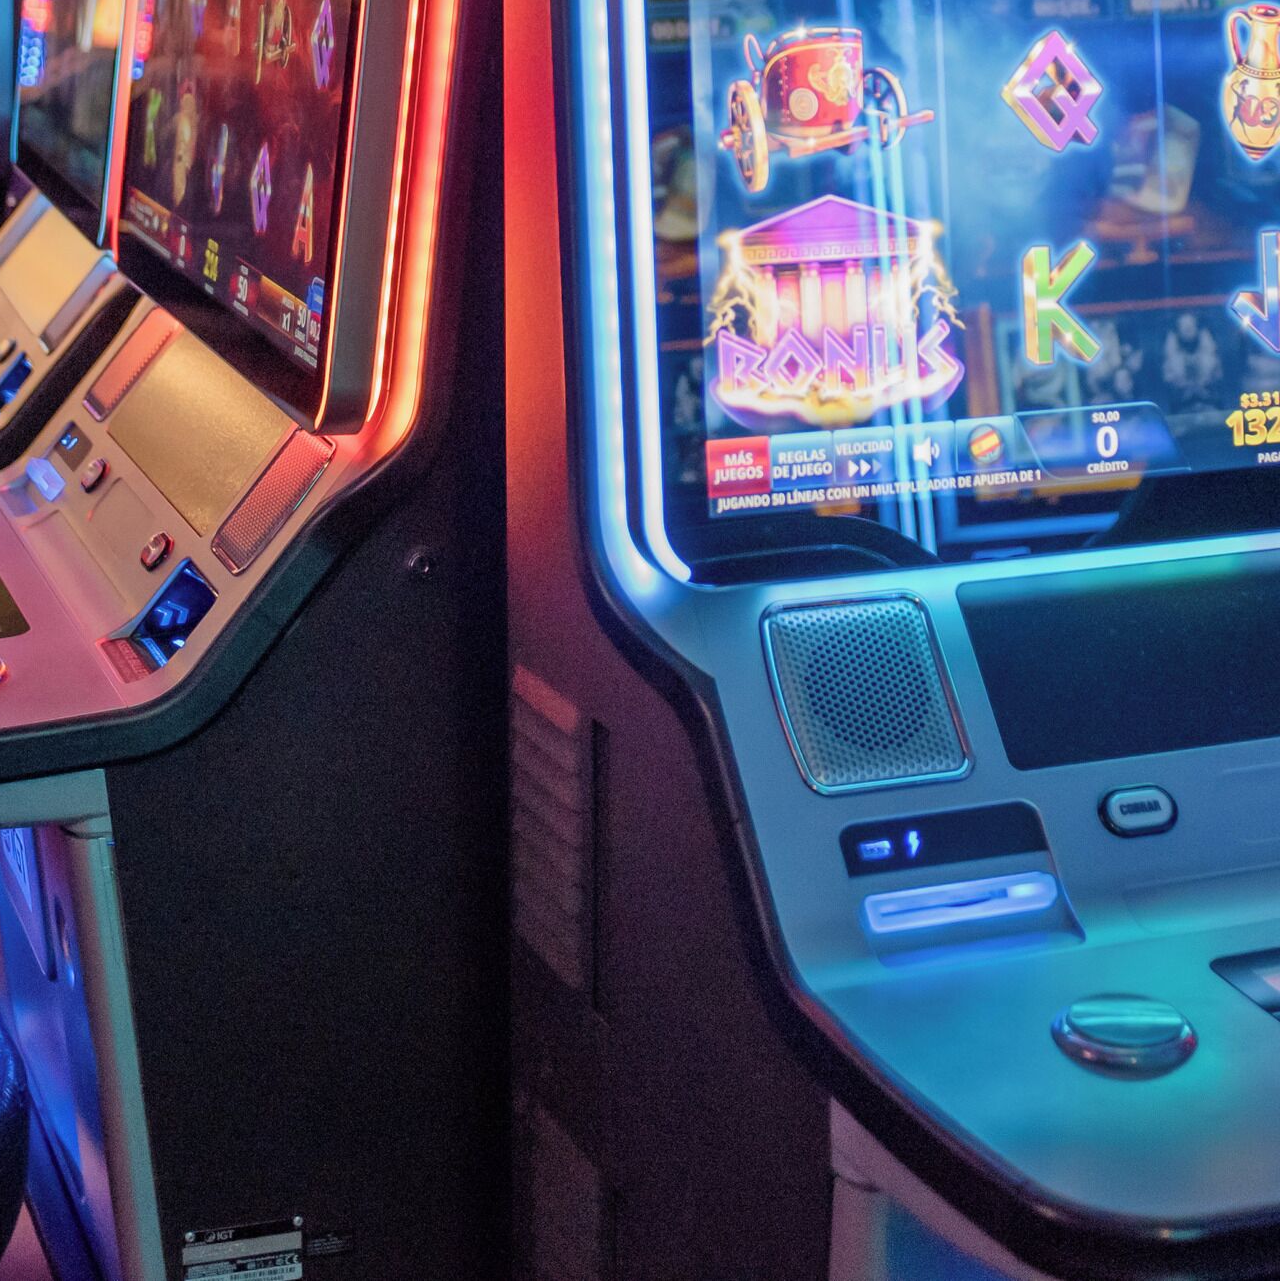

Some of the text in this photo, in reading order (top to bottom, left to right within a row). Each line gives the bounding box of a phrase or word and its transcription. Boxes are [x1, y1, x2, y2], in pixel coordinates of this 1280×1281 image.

[1022, 241, 1101, 365] K
[719, 319, 965, 396] BONUS
[835, 439, 893, 456] VELOCIDAD
[1096, 425, 1119, 458] 0
[724, 450, 754, 466] MÁS
[778, 448, 827, 464] REGLAS
[714, 465, 764, 485] JUEGOS
[773, 462, 833, 481] DE JUEGO
[1087, 460, 1129, 474] CRÉDITO
[717, 469, 1042, 514] JUGANDO 50 LÍNEAS CON UN MULTIPLICADOR DE APUESTA DE 1
